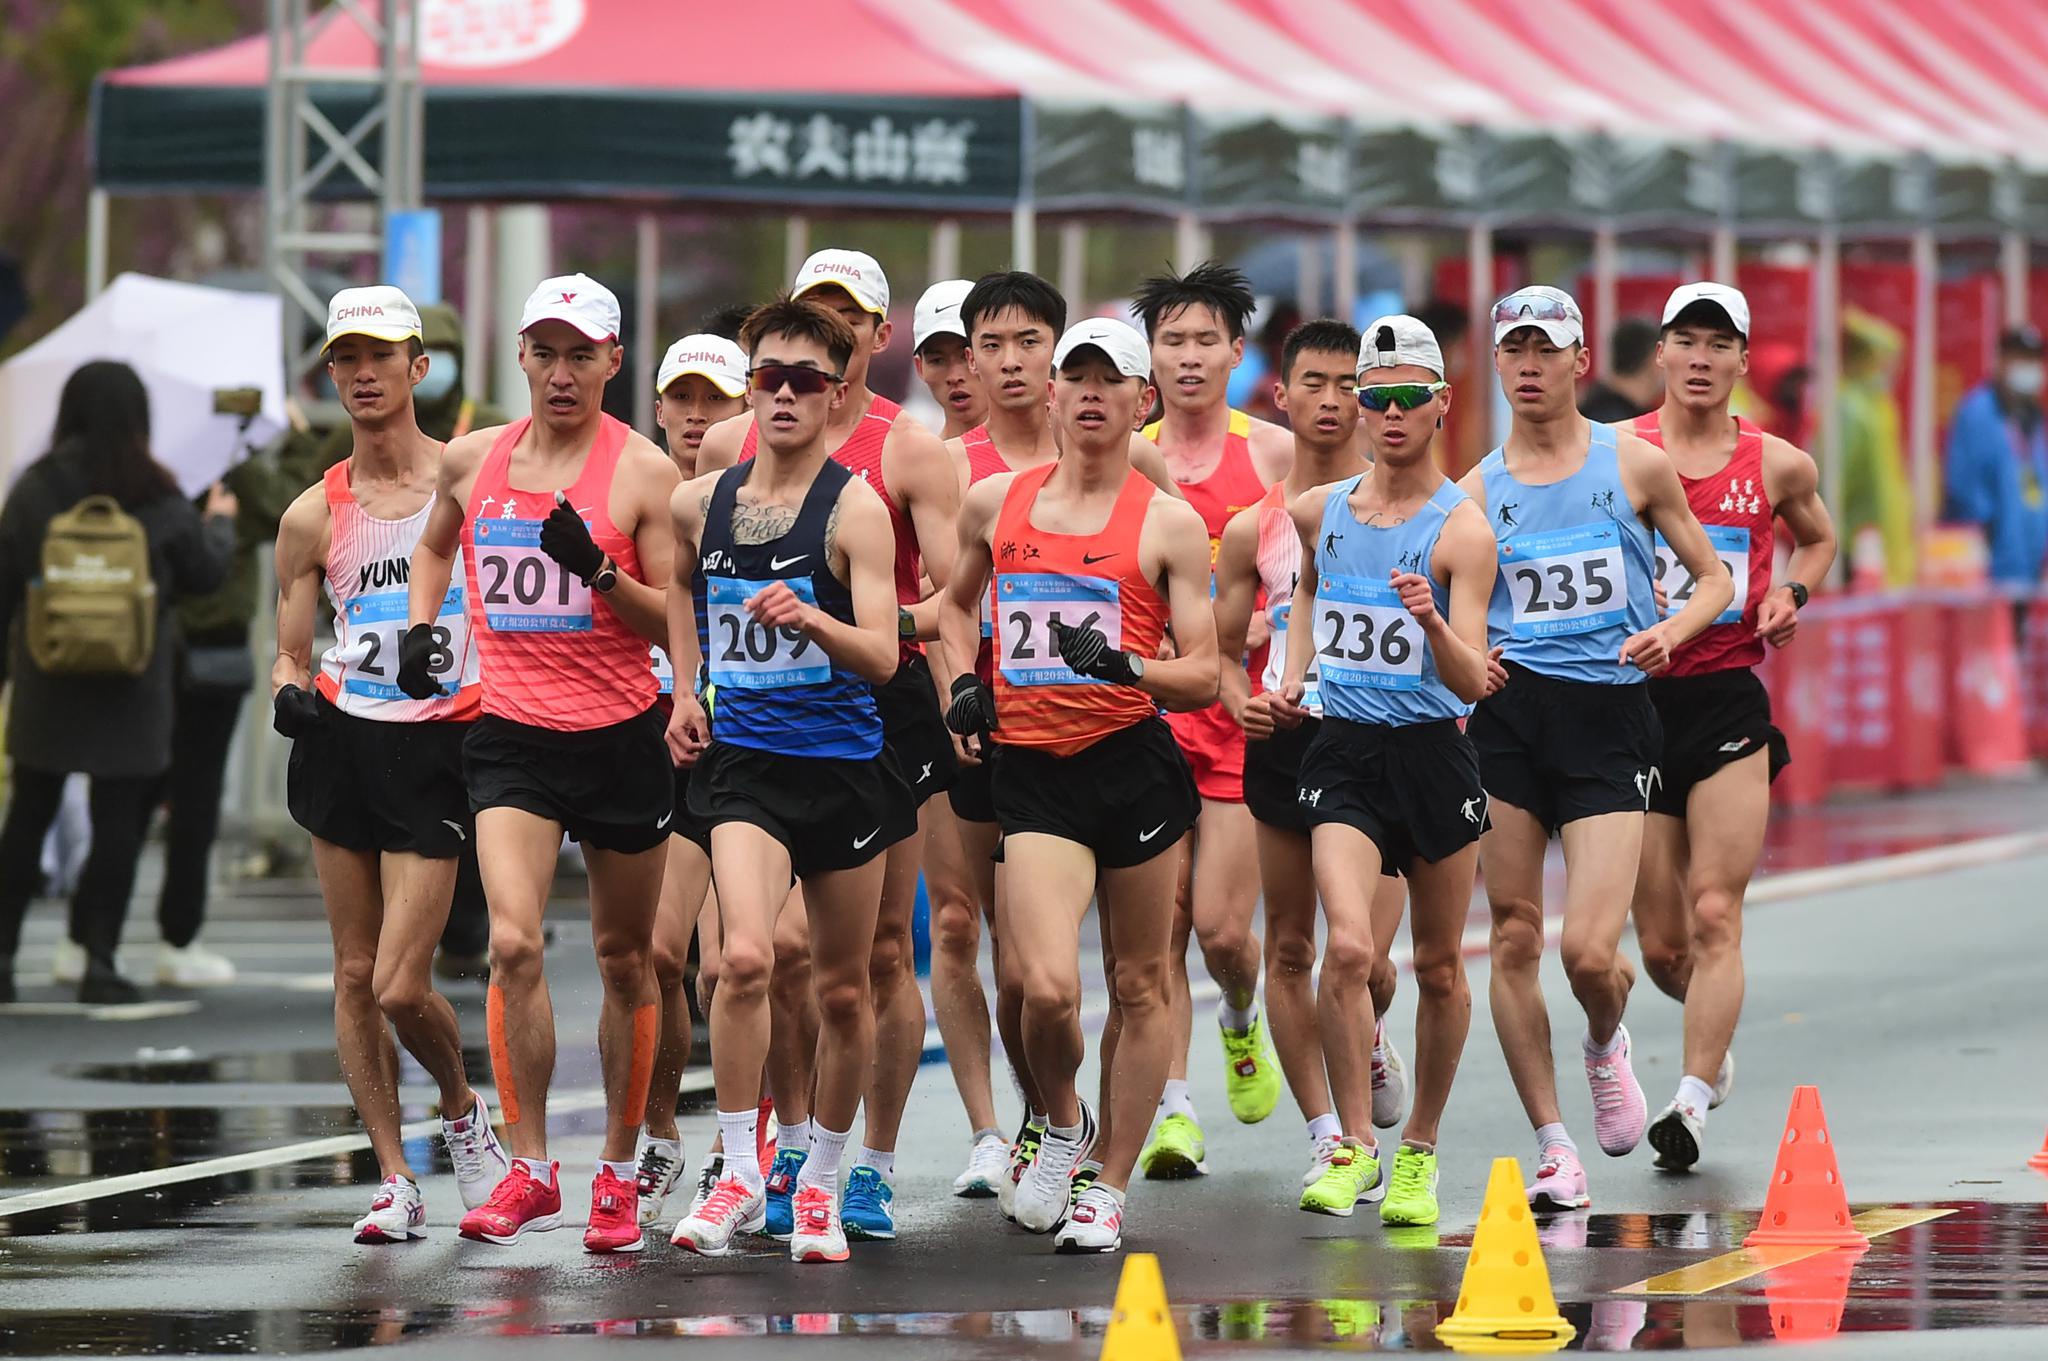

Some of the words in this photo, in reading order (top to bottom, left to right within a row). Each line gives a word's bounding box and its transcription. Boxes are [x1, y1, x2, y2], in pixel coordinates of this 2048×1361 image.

[813, 263, 861, 281] CHINA
[336, 306, 385, 321] CHINA
[678, 352, 727, 366] CHINA
[476, 495, 517, 520] 广东
[1591, 489, 1615, 516] 天津
[1719, 493, 1761, 515] 内蒙古
[1000, 541, 1041, 562] 浙江
[1397, 550, 1422, 574] 天津
[359, 556, 412, 593] YUNN
[483, 555, 570, 605] 201
[1516, 558, 1613, 614] 235
[719, 613, 812, 663] 209
[1320, 610, 1411, 666] 236
